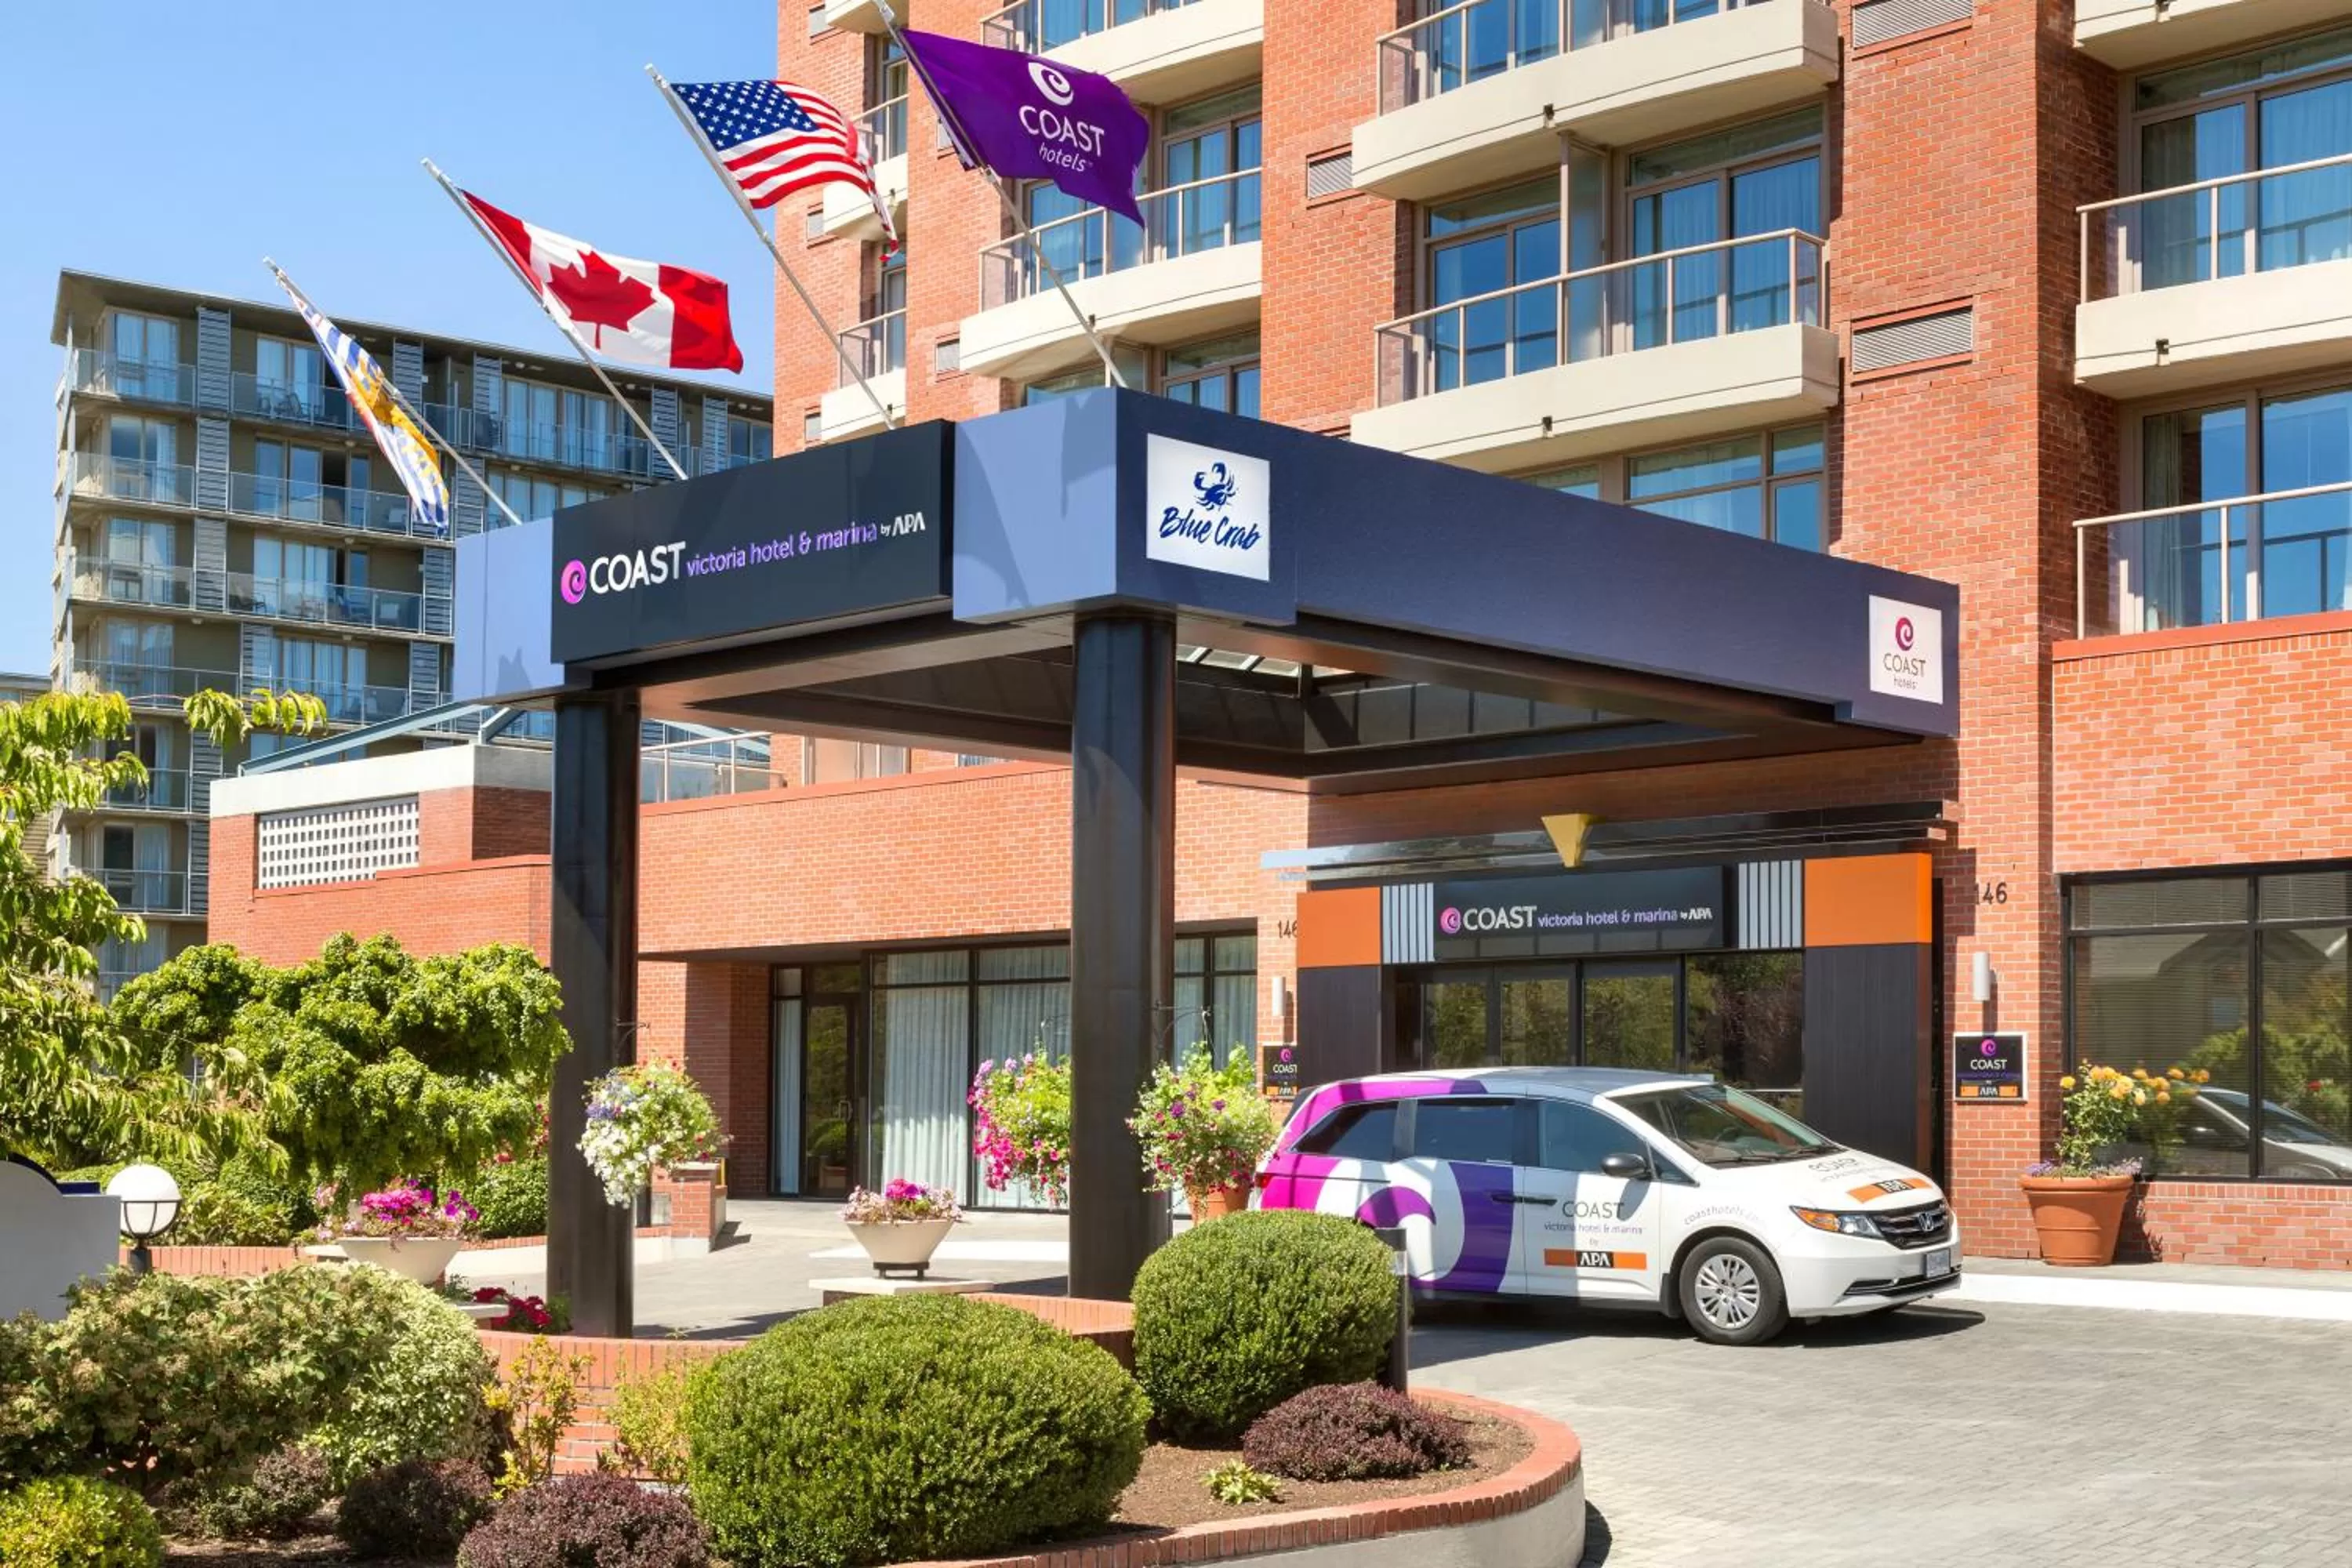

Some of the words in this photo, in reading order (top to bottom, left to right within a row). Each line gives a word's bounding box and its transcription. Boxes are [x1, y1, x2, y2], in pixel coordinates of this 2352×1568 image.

[1019, 105, 1105, 157] COAST
[1040, 142, 1086, 172] hotels
[1160, 506, 1212, 543] Blue
[1214, 516, 1261, 550] Crab
[590, 541, 686, 594] COAST
[686, 546, 746, 577] victoria
[750, 535, 794, 565] hotel
[799, 531, 811, 554] &
[815, 521, 878, 551] marina
[880, 524, 890, 537] by
[891, 511, 926, 536] APA
[1883, 653, 1926, 678] COAST
[1462, 906, 1537, 931] COAST
[1537, 913, 1583, 927] victoria
[1586, 910, 1618, 925] hotel
[1621, 909, 1631, 924] &
[1634, 908, 1679, 923] marina
[1272, 1064, 1298, 1073] COAST
[1970, 1059, 2007, 1070] COAST
[1562, 1200, 1624, 1219] COAST
[1581, 1252, 1610, 1266] APA
